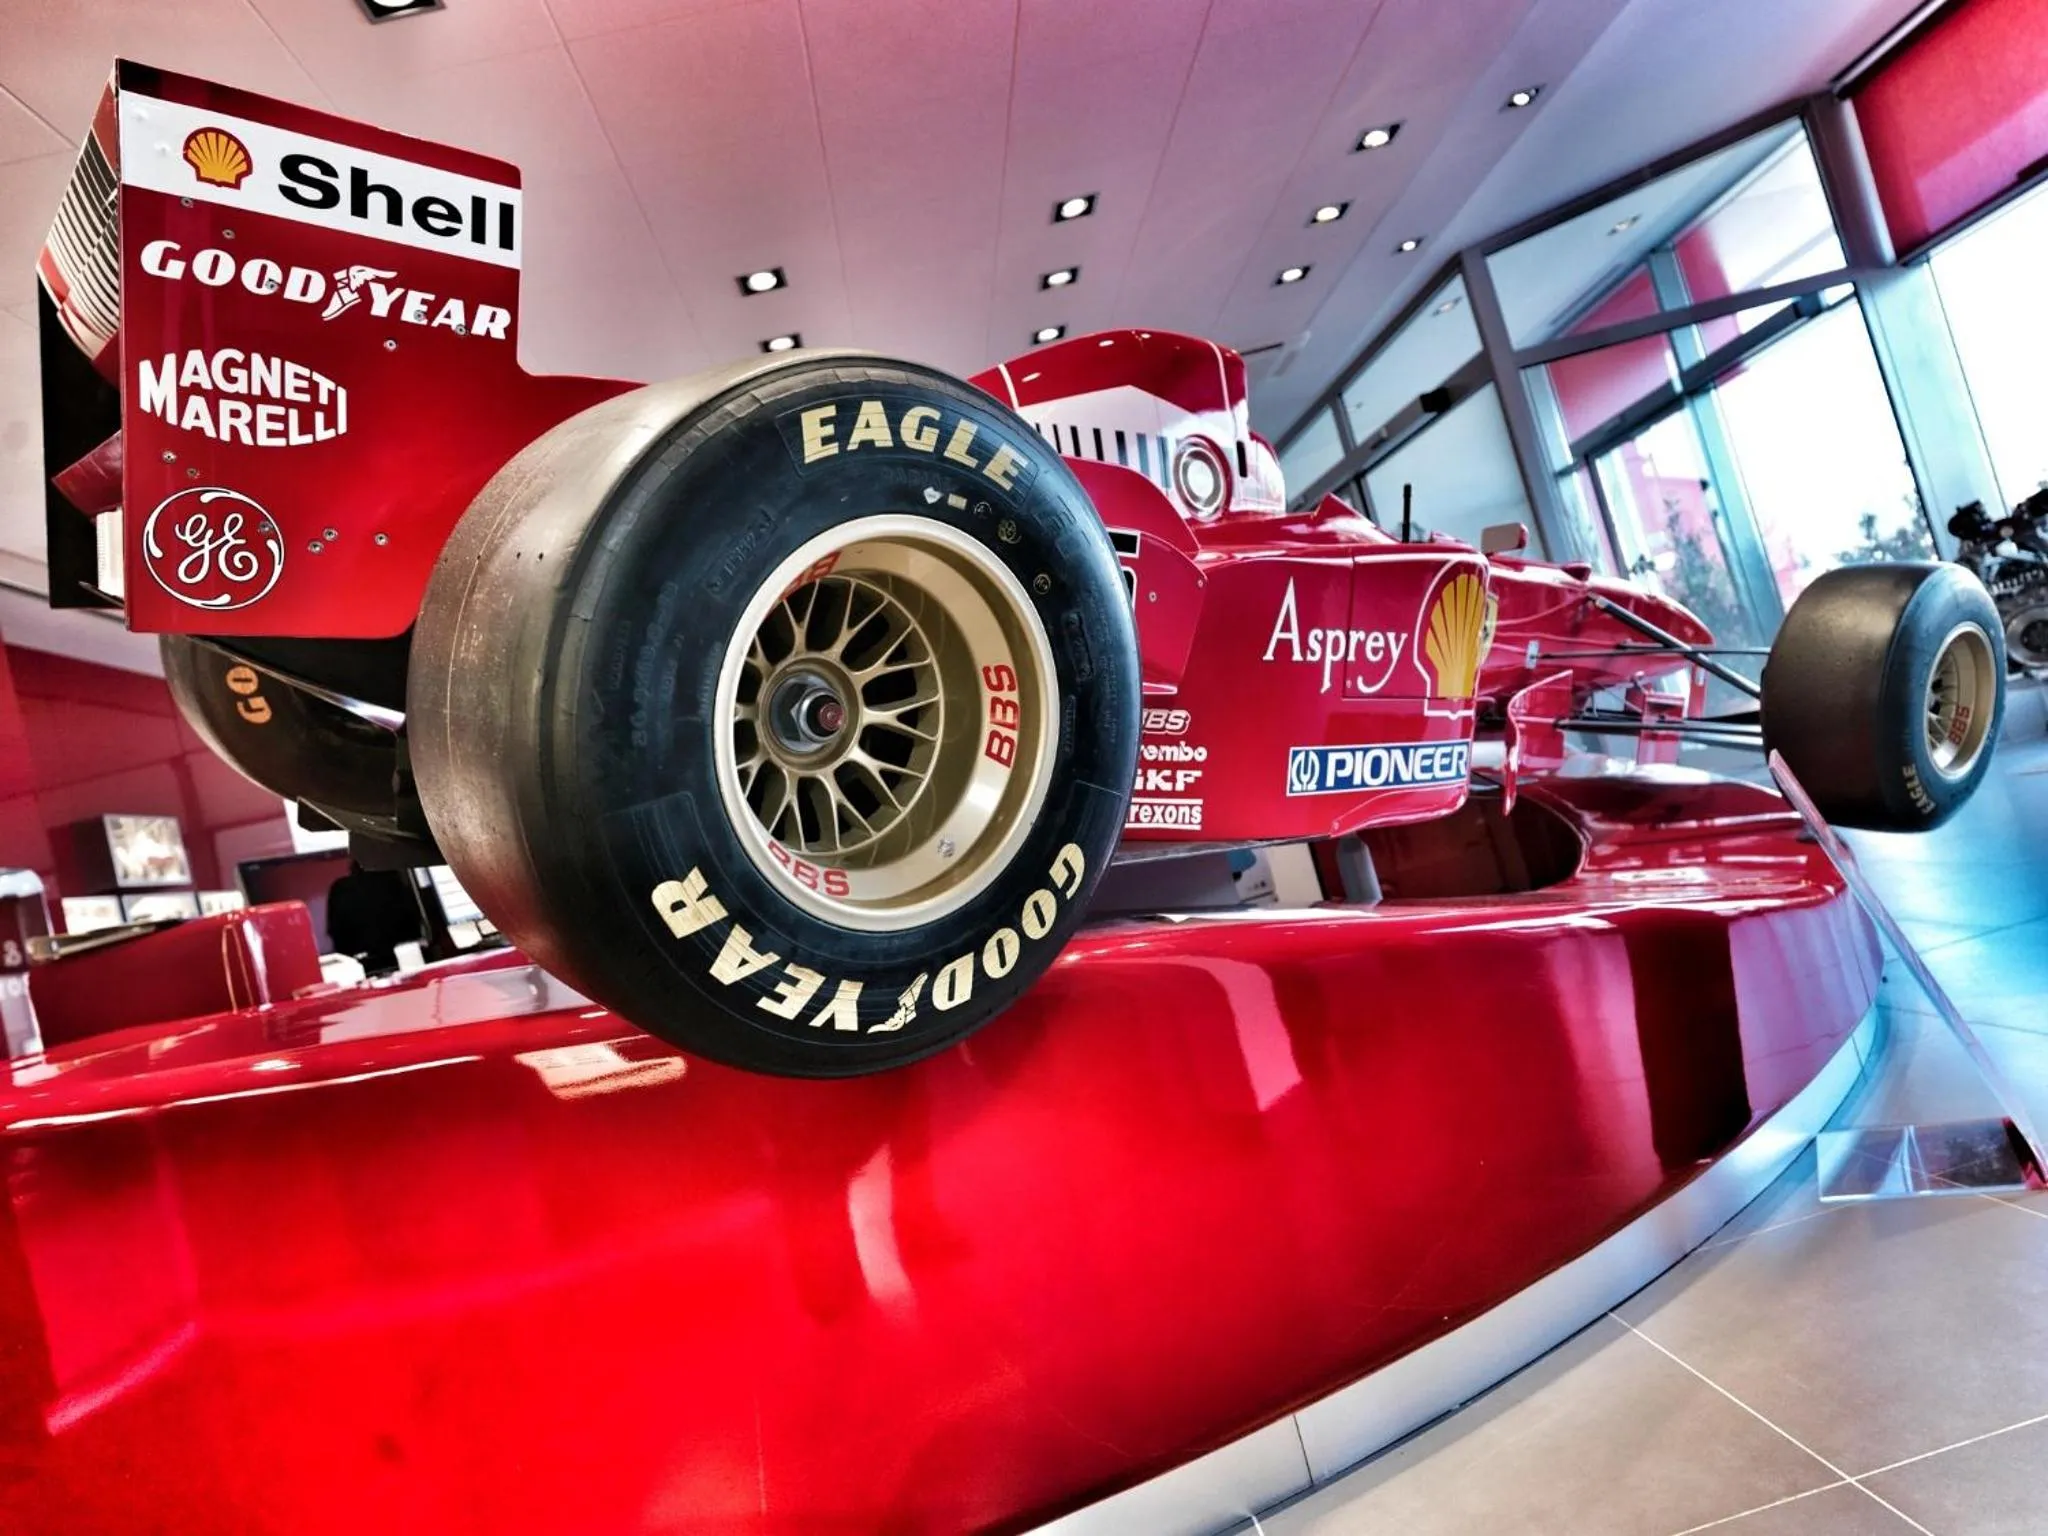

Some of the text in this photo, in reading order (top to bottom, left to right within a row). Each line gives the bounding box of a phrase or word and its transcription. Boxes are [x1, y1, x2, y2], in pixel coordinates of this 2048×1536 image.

[279, 153, 516, 251] Shell
[139, 348, 348, 416] MAGNETI
[139, 372, 348, 447] MARELLI
[800, 400, 1030, 492] EAGLE
[1262, 577, 1408, 694] Asprey
[982, 664, 1019, 768] BBS
[1141, 741, 1208, 762] embo
[1142, 708, 1189, 732] BS
[1325, 745, 1468, 788] PIONEER
[1127, 804, 1202, 824] rexons
